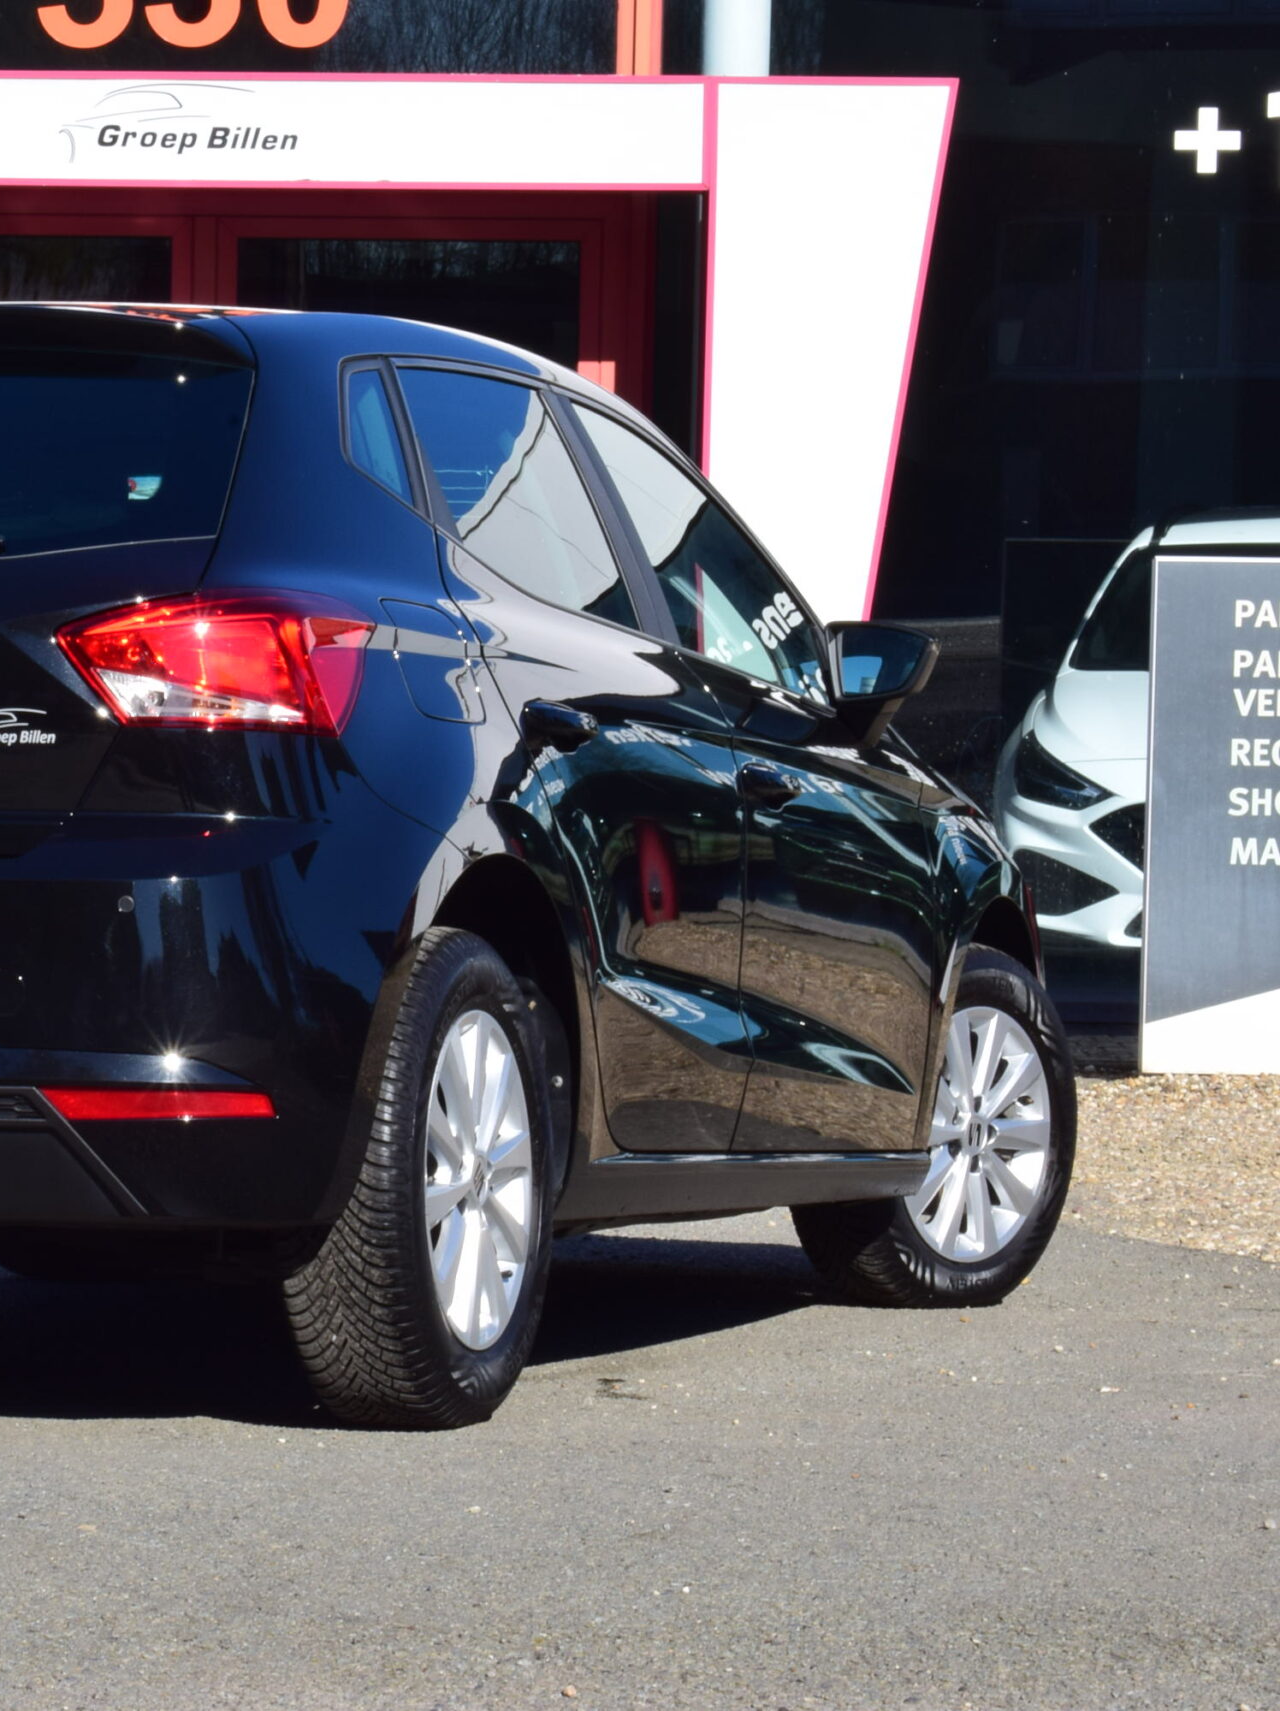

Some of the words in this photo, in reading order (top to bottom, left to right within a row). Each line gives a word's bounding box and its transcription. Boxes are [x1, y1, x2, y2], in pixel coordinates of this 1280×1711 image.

[97, 124, 198, 155] Groep
[207, 127, 299, 151] Billen
[1234, 599, 1280, 628] PA
[1233, 649, 1280, 678] PA
[1232, 688, 1280, 717] VE
[19, 729, 57, 744] Billen
[1227, 787, 1280, 816] SH
